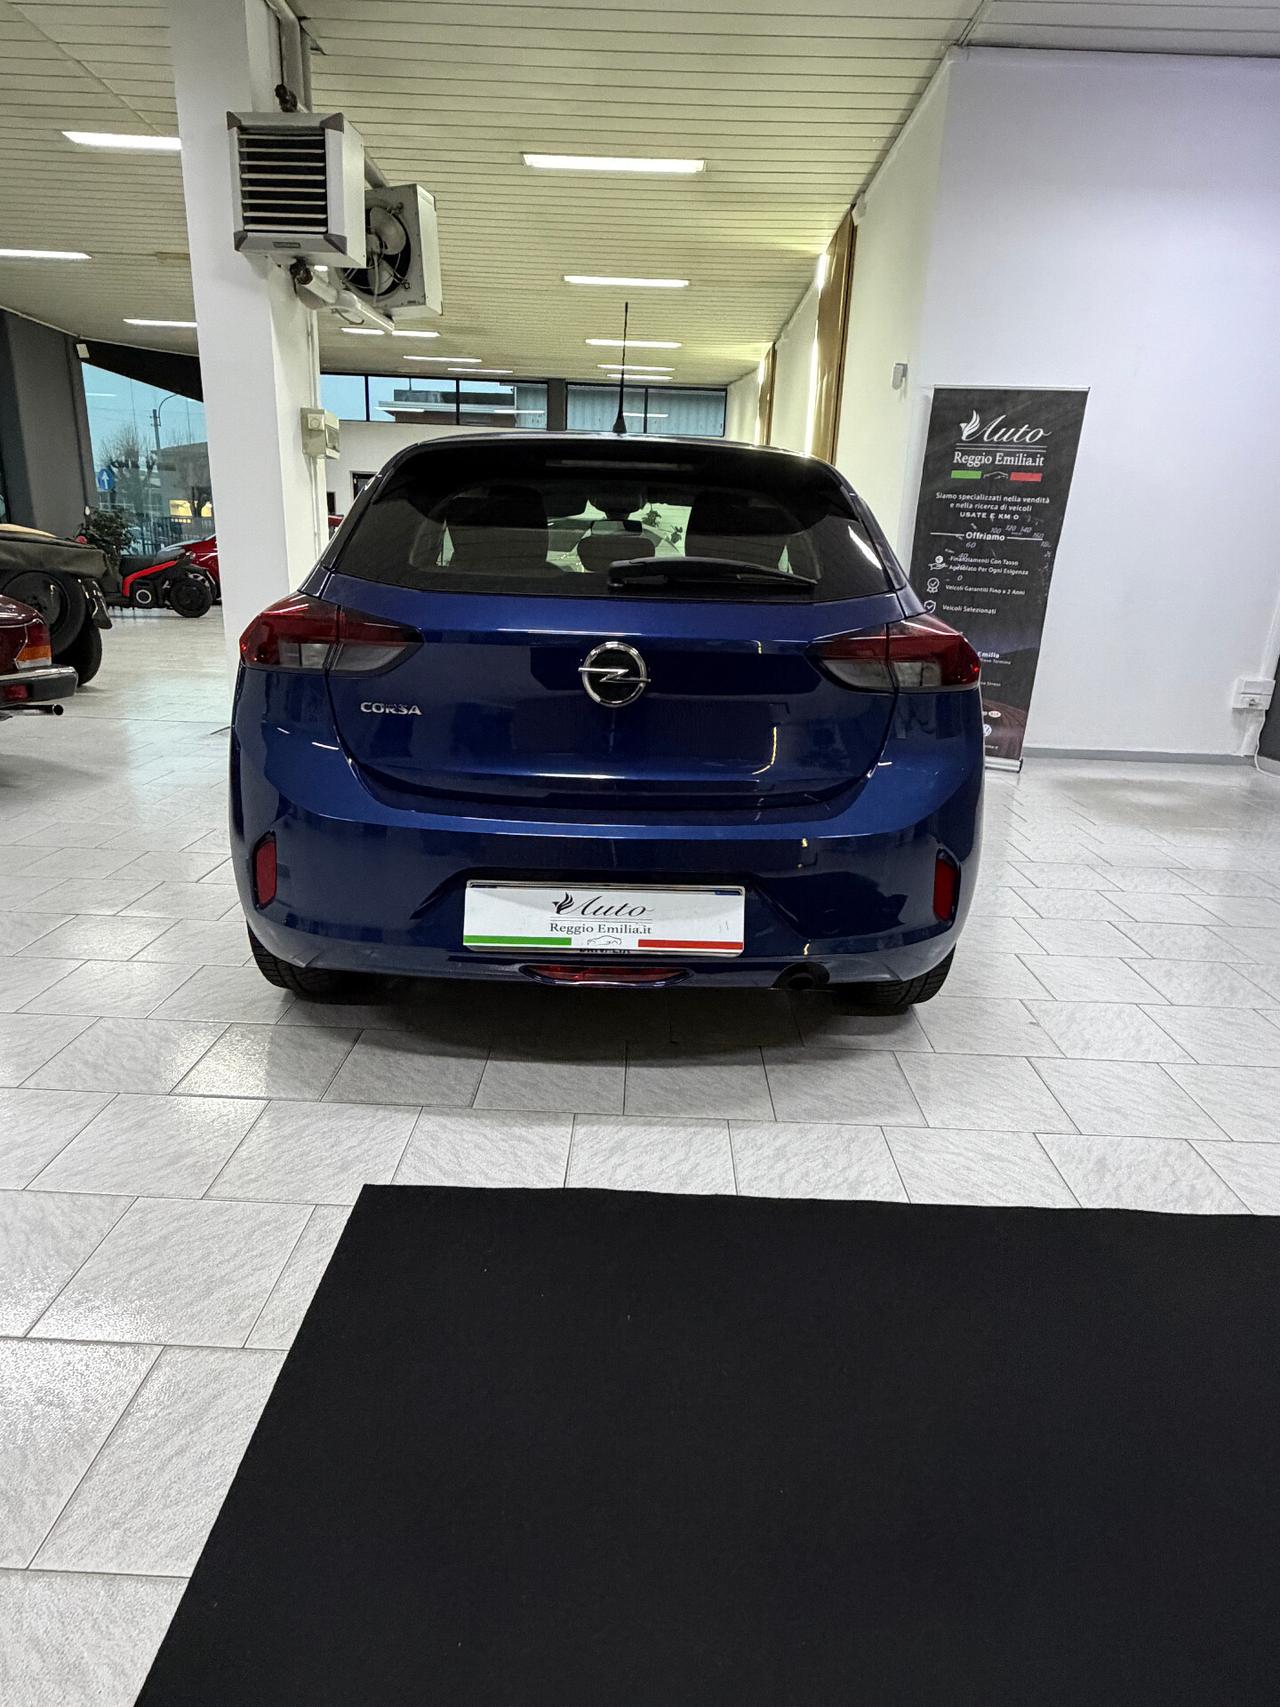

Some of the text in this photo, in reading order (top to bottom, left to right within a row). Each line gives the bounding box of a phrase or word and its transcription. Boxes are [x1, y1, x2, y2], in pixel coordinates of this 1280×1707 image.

[961, 413, 1051, 442] Auto
[953, 451, 1044, 467] Reggio Emilia.it
[936, 492, 957, 500] Siamo
[958, 494, 1001, 502] specializzati
[1000, 503, 1007, 511] di
[965, 532, 1005, 541] Offriamo
[360, 702, 423, 715] CORSA
[556, 894, 655, 917] Auto
[549, 922, 652, 936] Reggio Emilia.it
